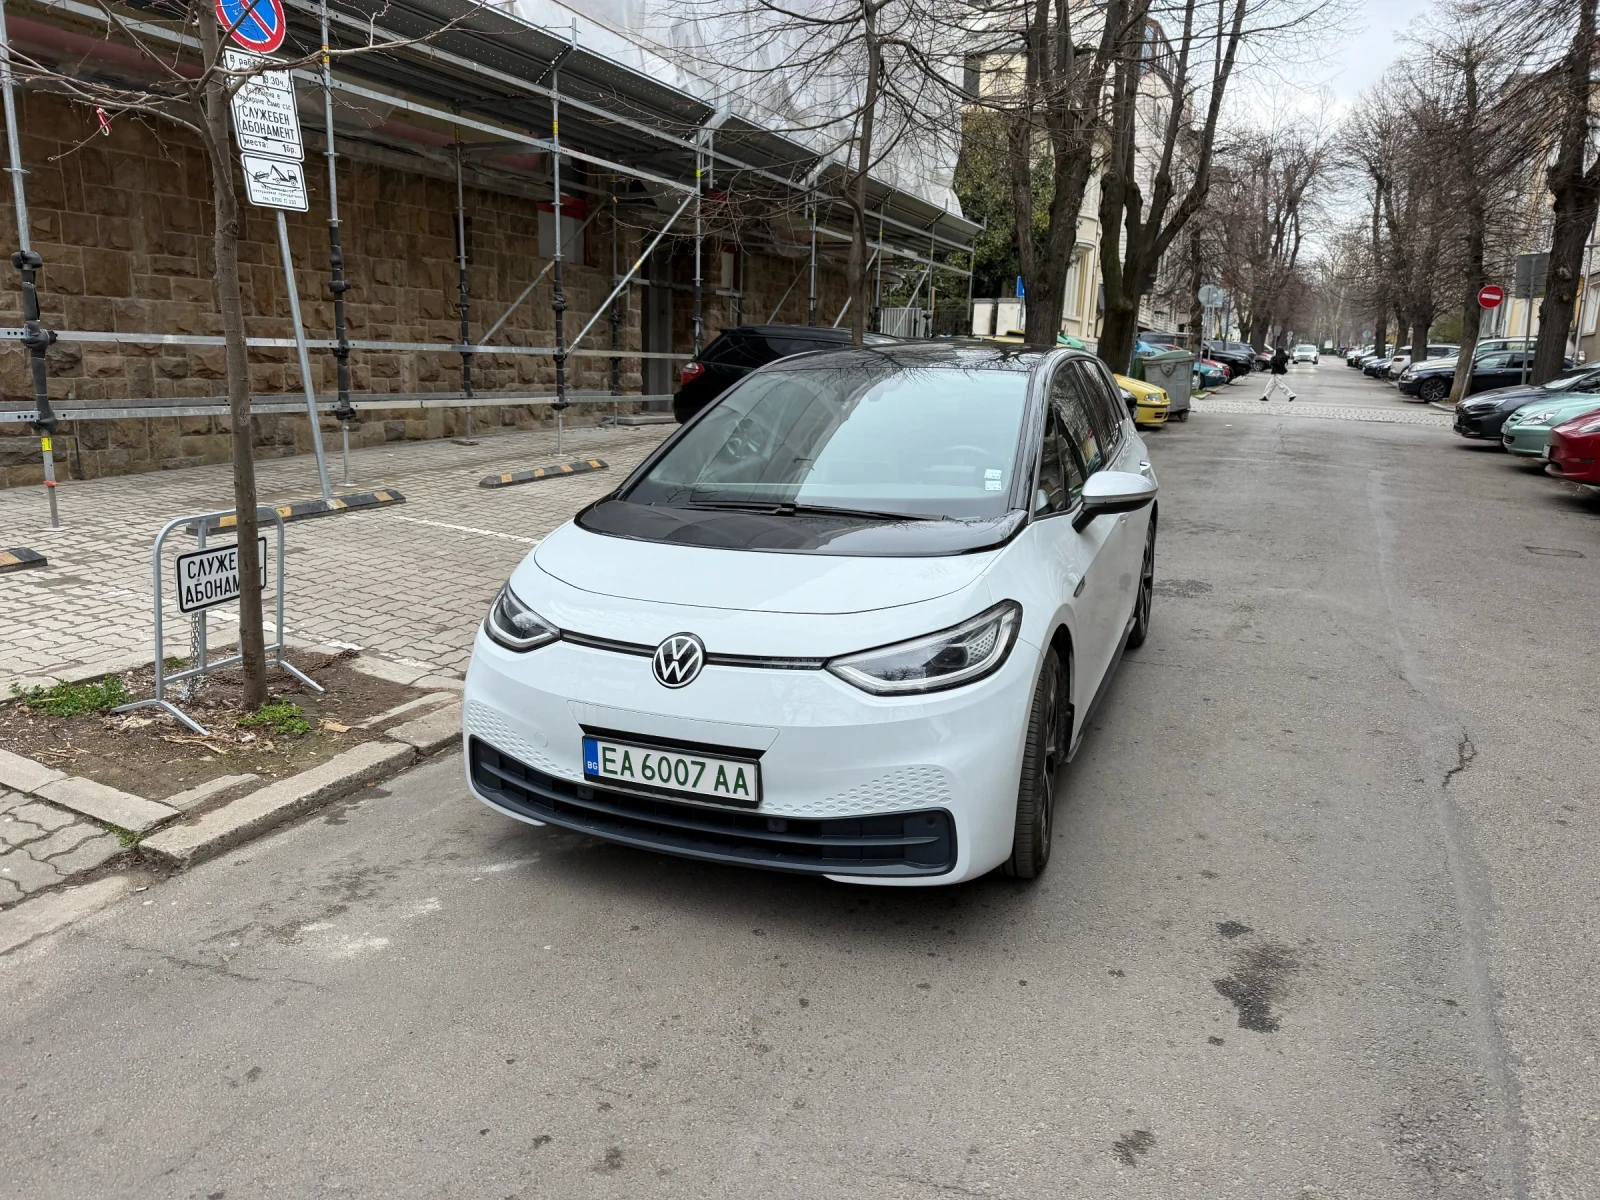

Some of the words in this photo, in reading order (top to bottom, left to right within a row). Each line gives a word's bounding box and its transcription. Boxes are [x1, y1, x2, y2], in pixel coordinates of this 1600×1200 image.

[242, 105, 290, 126] СЛУЖЕБЕН
[242, 120, 295, 140] АБОНАМЕНТ
[187, 552, 237, 579] СЛУЖЕ
[587, 760, 598, 770] BG
[602, 746, 635, 779] EA
[641, 753, 706, 789] 6007
[713, 764, 749, 797] AA
